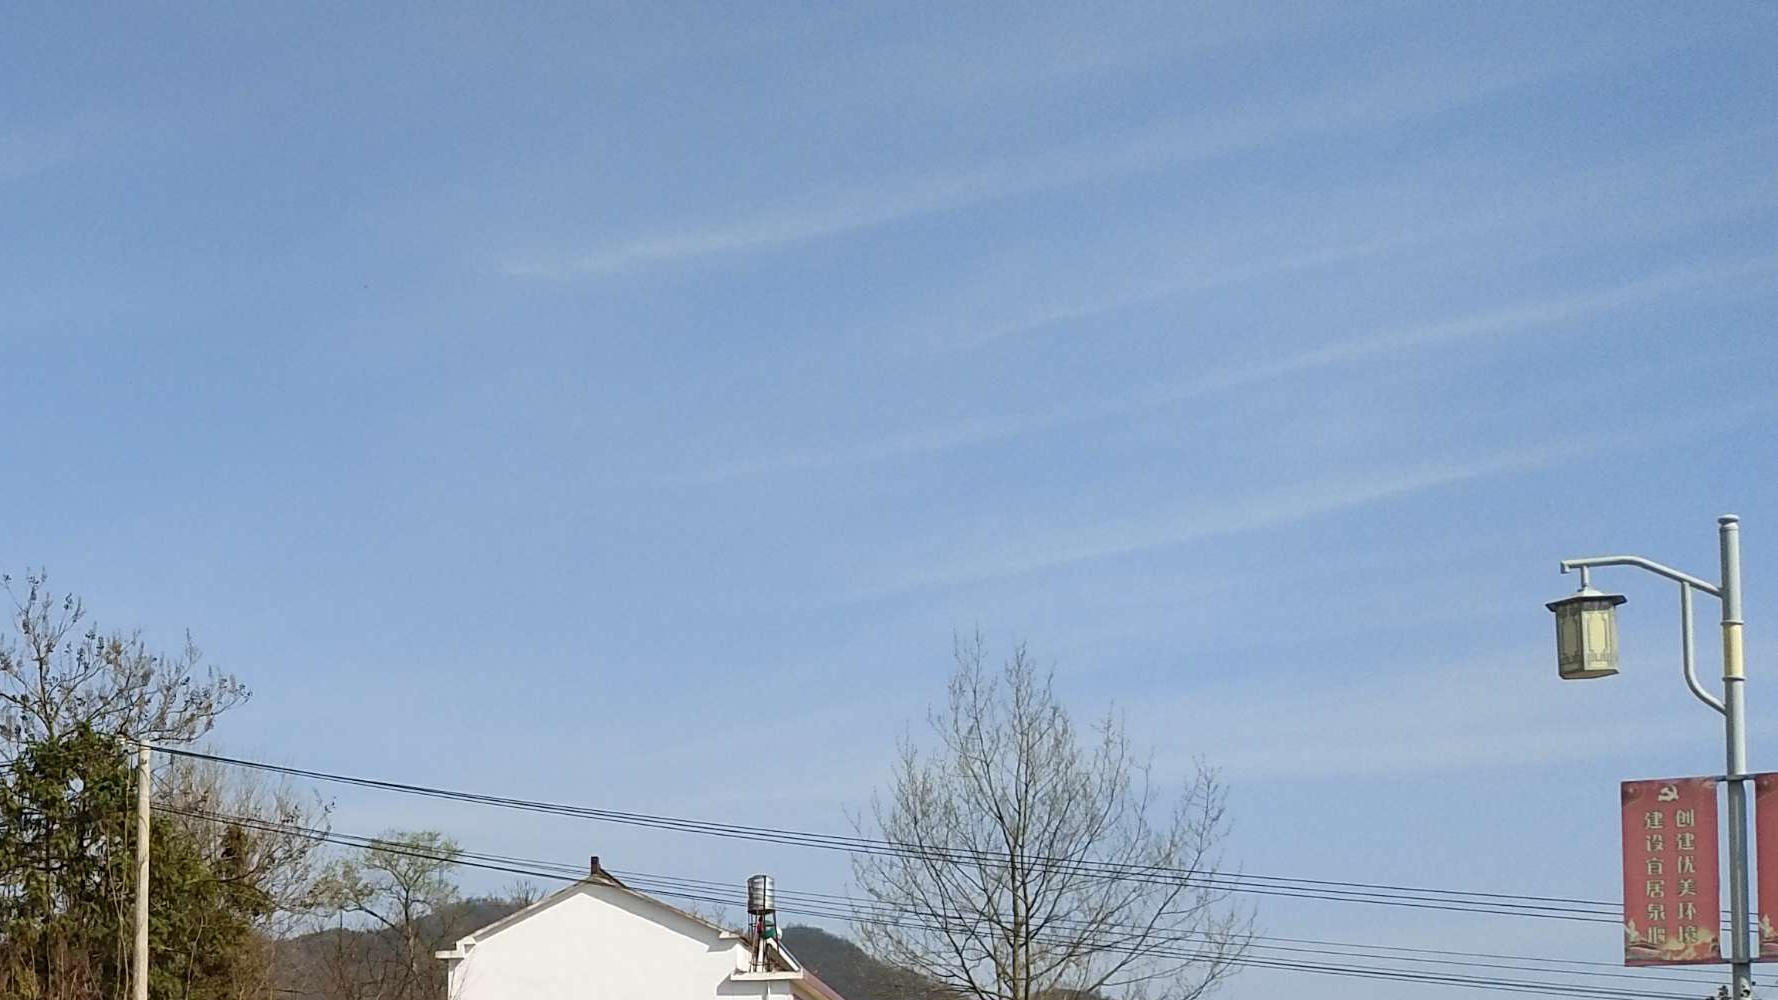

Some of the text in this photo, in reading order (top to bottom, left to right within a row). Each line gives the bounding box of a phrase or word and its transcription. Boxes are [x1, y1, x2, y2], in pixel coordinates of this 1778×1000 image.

[1675, 809, 1697, 943] 创建优美环境
